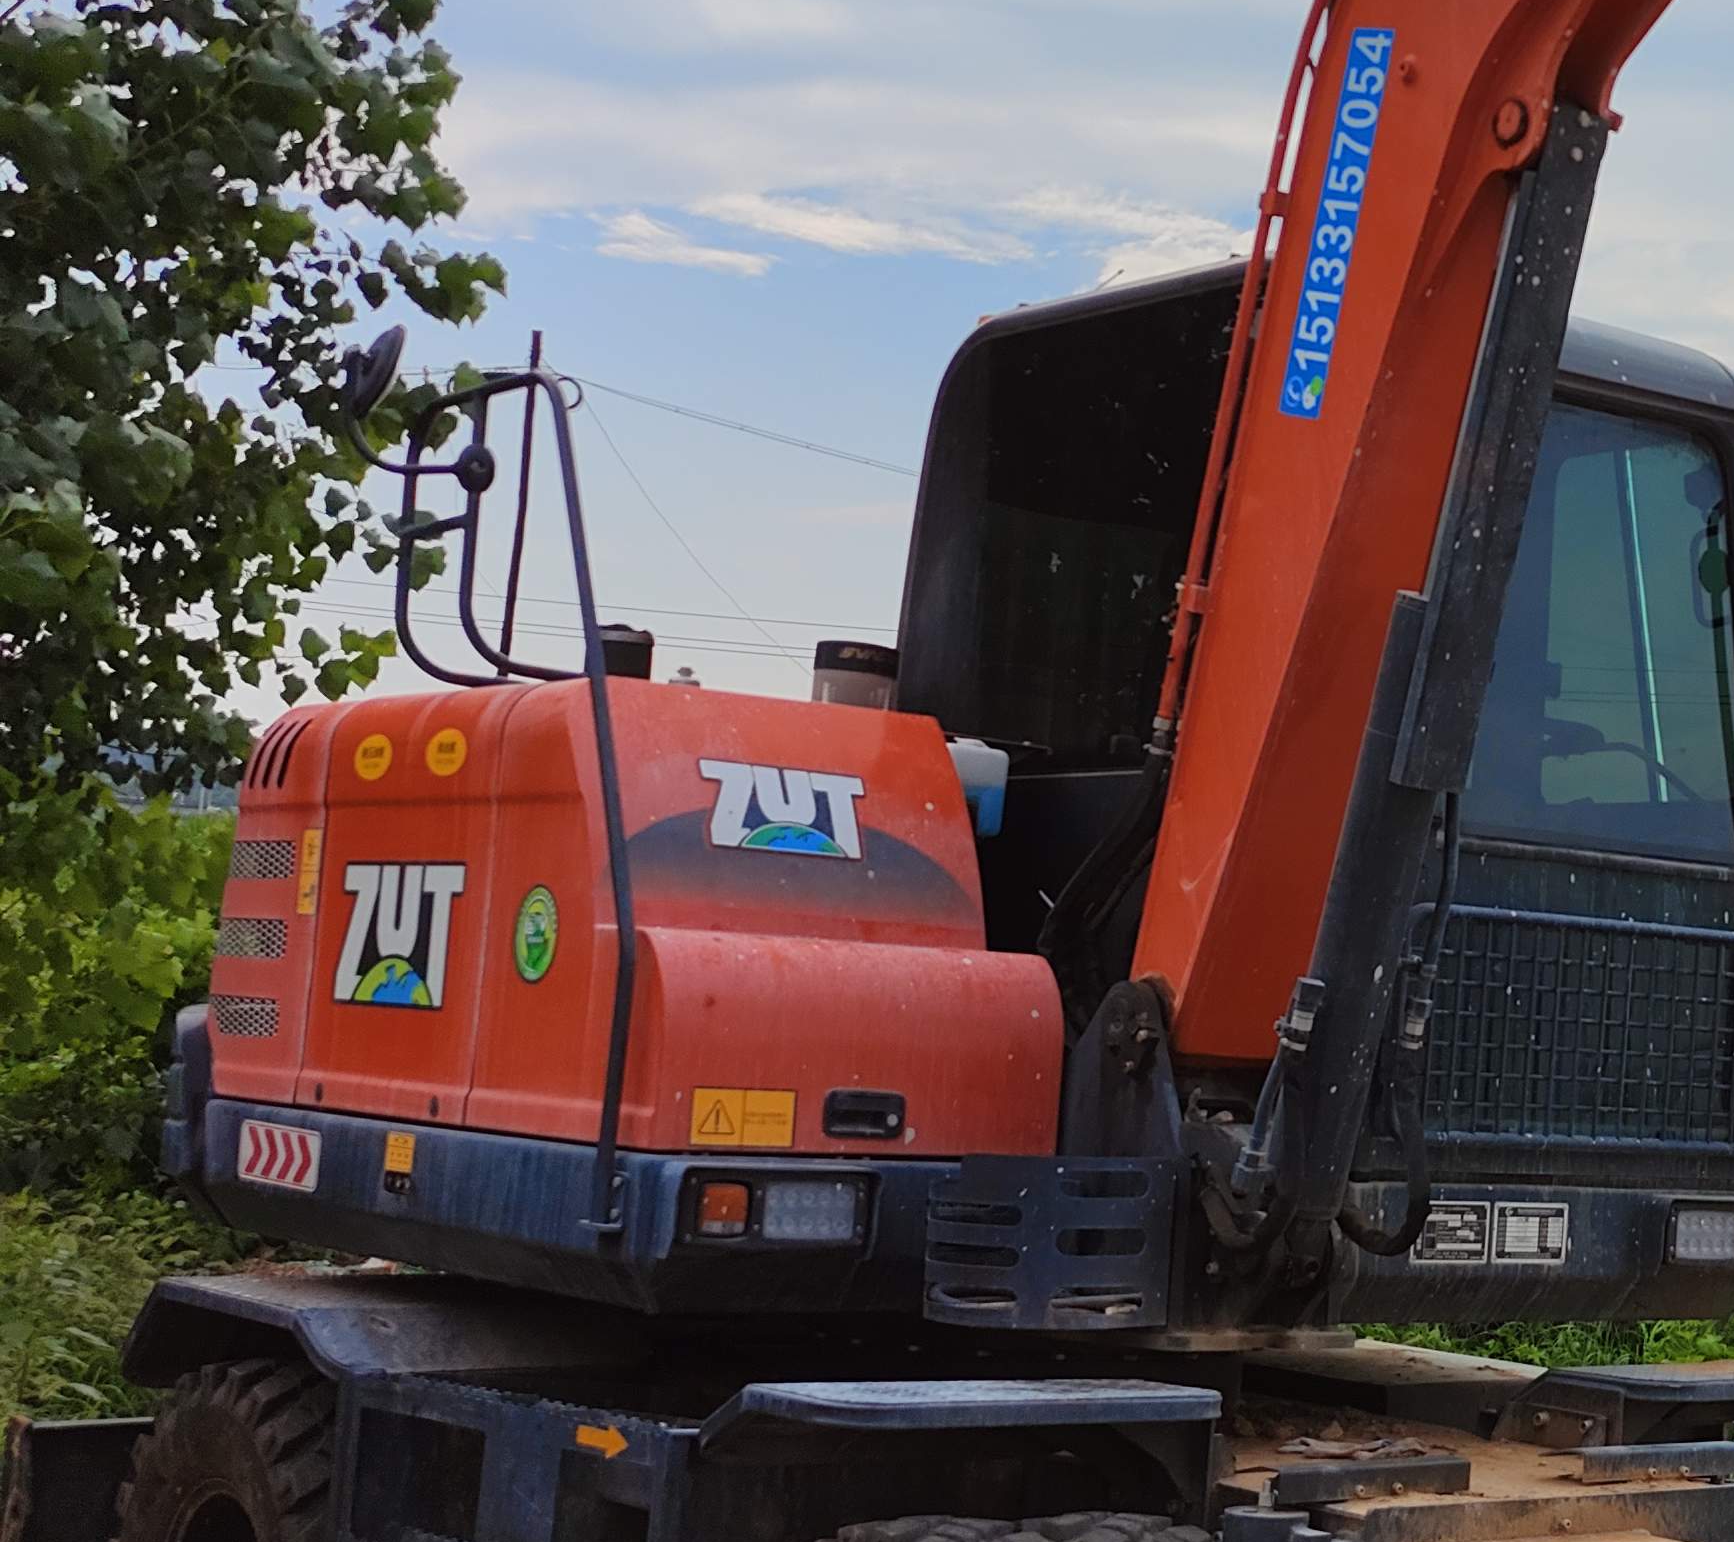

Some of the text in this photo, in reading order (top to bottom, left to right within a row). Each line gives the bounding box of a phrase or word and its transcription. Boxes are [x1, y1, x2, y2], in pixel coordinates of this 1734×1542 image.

[1293, 31, 1394, 372] 15133157054
[699, 758, 865, 860] ZUT
[333, 864, 466, 1008] ZUT
